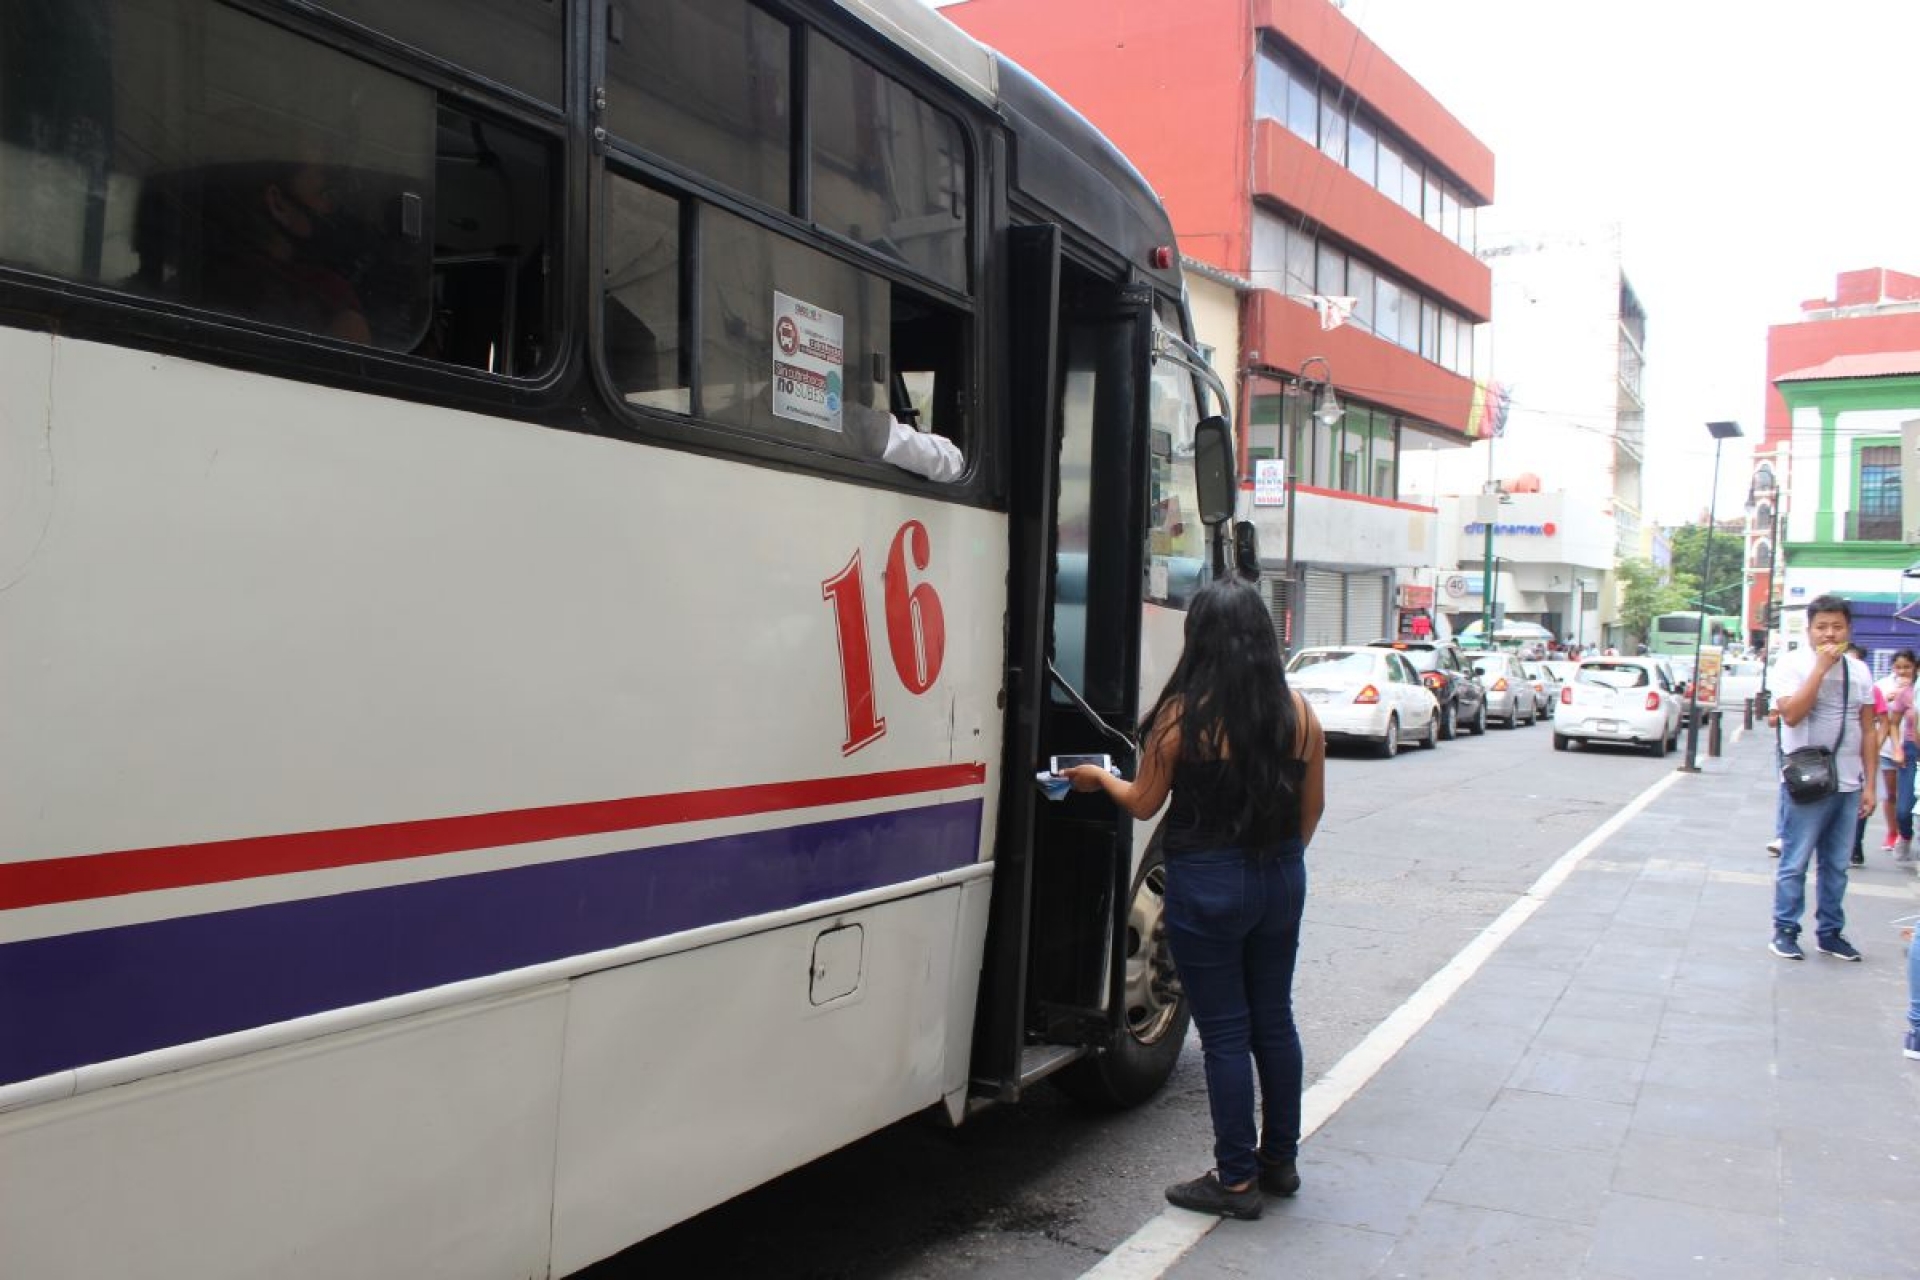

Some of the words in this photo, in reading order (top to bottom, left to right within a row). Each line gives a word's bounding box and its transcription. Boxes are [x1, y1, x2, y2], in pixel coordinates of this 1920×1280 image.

[777, 378, 794, 395] no
[795, 384, 825, 404] SUBES
[1464, 522, 1543, 536] citianamex
[1450, 578, 1465, 590] 40
[821, 519, 946, 757] 16
